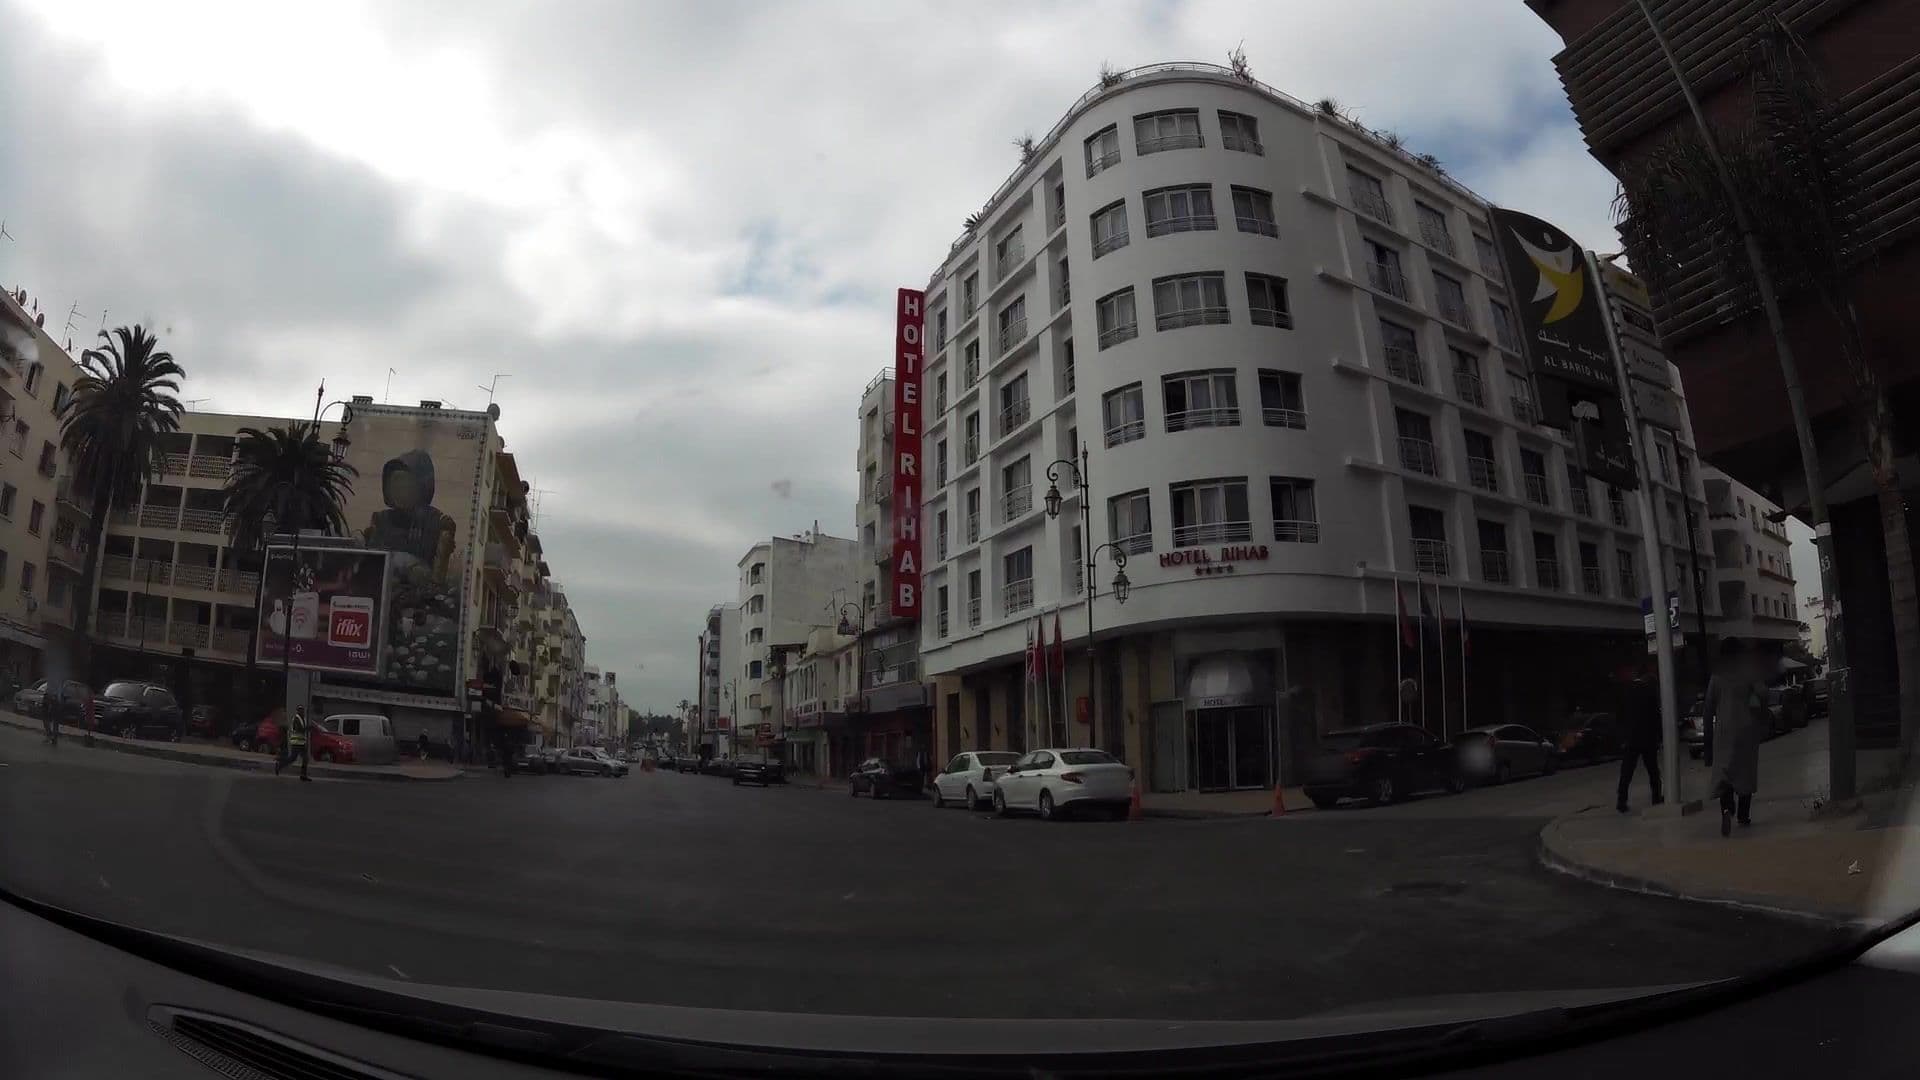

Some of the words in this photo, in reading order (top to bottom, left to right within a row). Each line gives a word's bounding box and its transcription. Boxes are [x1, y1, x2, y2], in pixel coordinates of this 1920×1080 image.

[902, 296, 919, 435] HOTEL
[1543, 355, 1558, 367] AL
[900, 453, 917, 607] RIHAB
[1160, 550, 1211, 568] HOTEL
[1222, 545, 1269, 562] RIHAB
[335, 619, 362, 637] iflix
